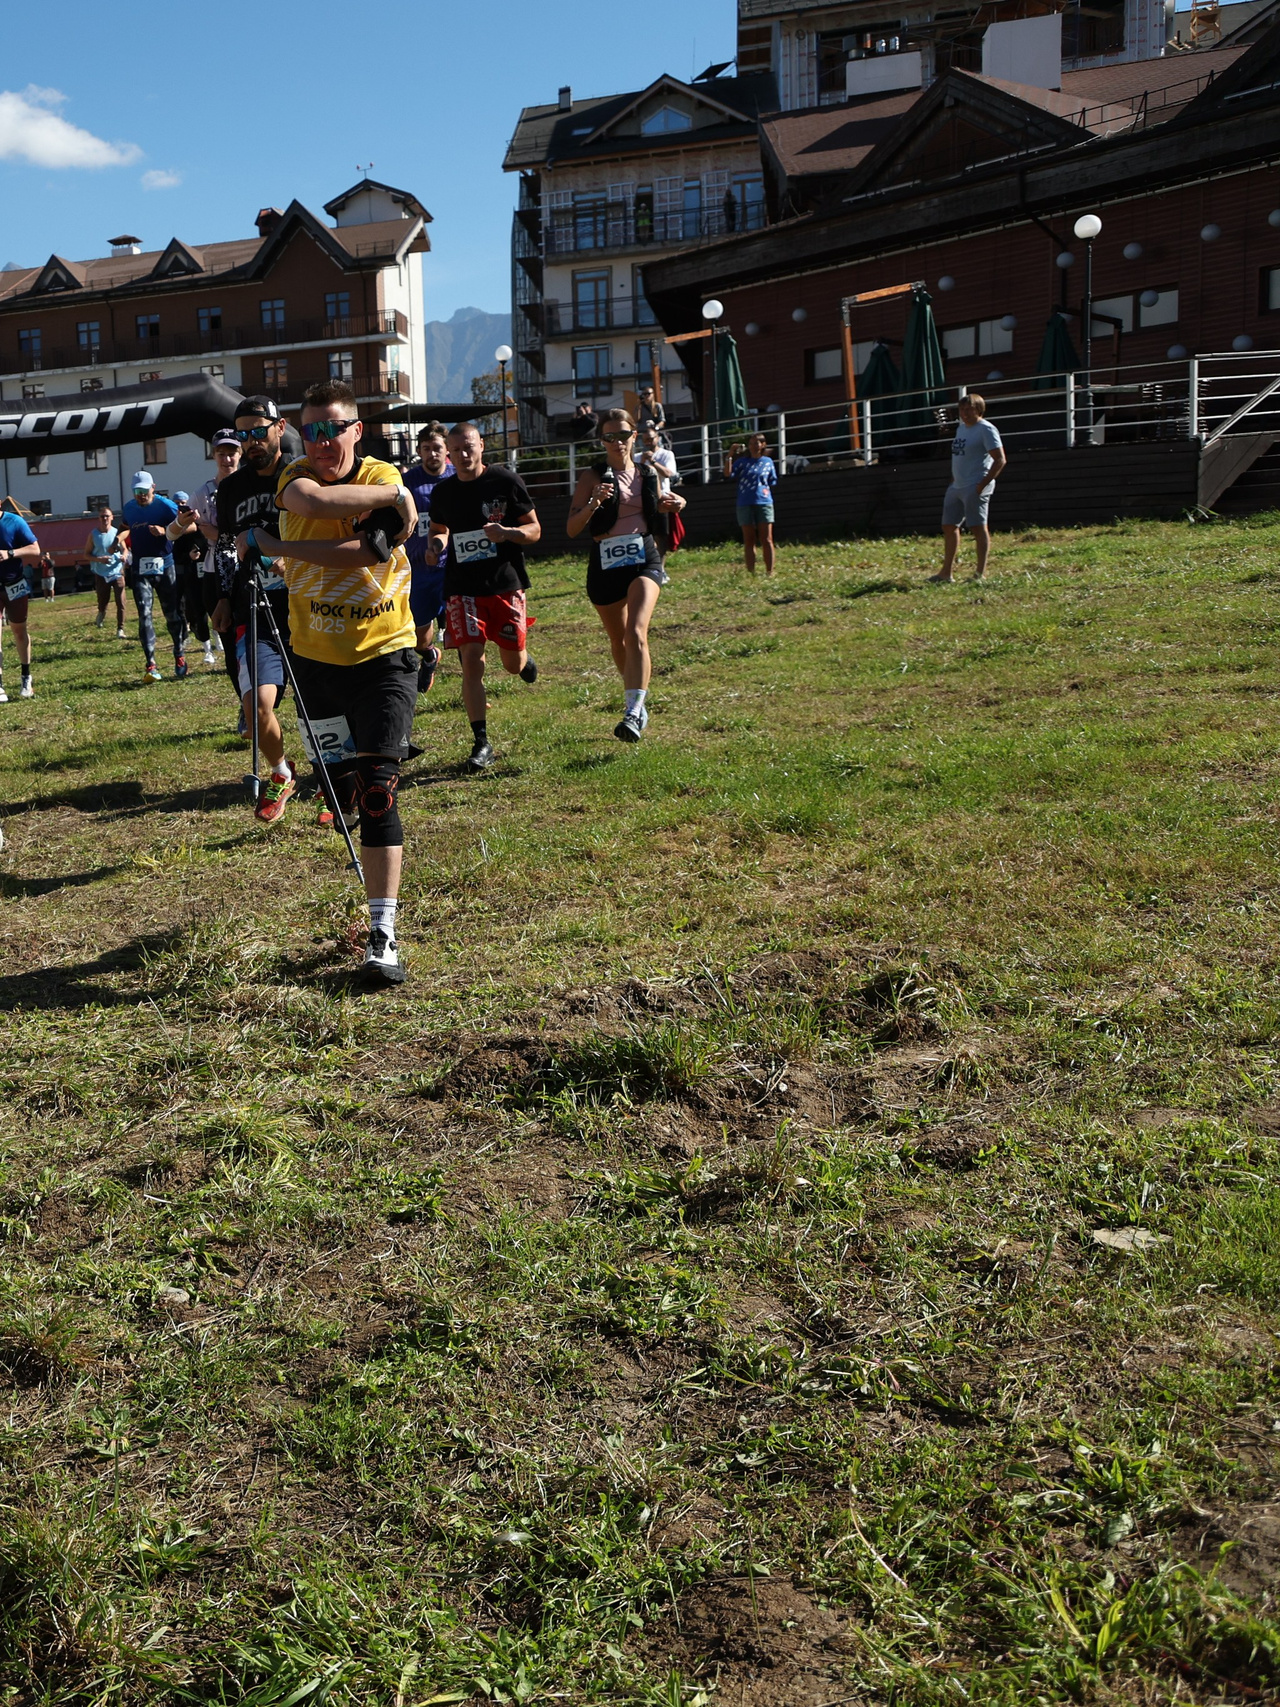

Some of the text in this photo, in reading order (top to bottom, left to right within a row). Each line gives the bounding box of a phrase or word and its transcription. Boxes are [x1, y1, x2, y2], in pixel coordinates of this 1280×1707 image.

[458, 538, 491, 554] 160
[604, 543, 640, 559] 168
[145, 562, 159, 570] 171
[11, 583, 26, 594] 174
[310, 600, 345, 618] КРОСС
[310, 614, 345, 634] 2025
